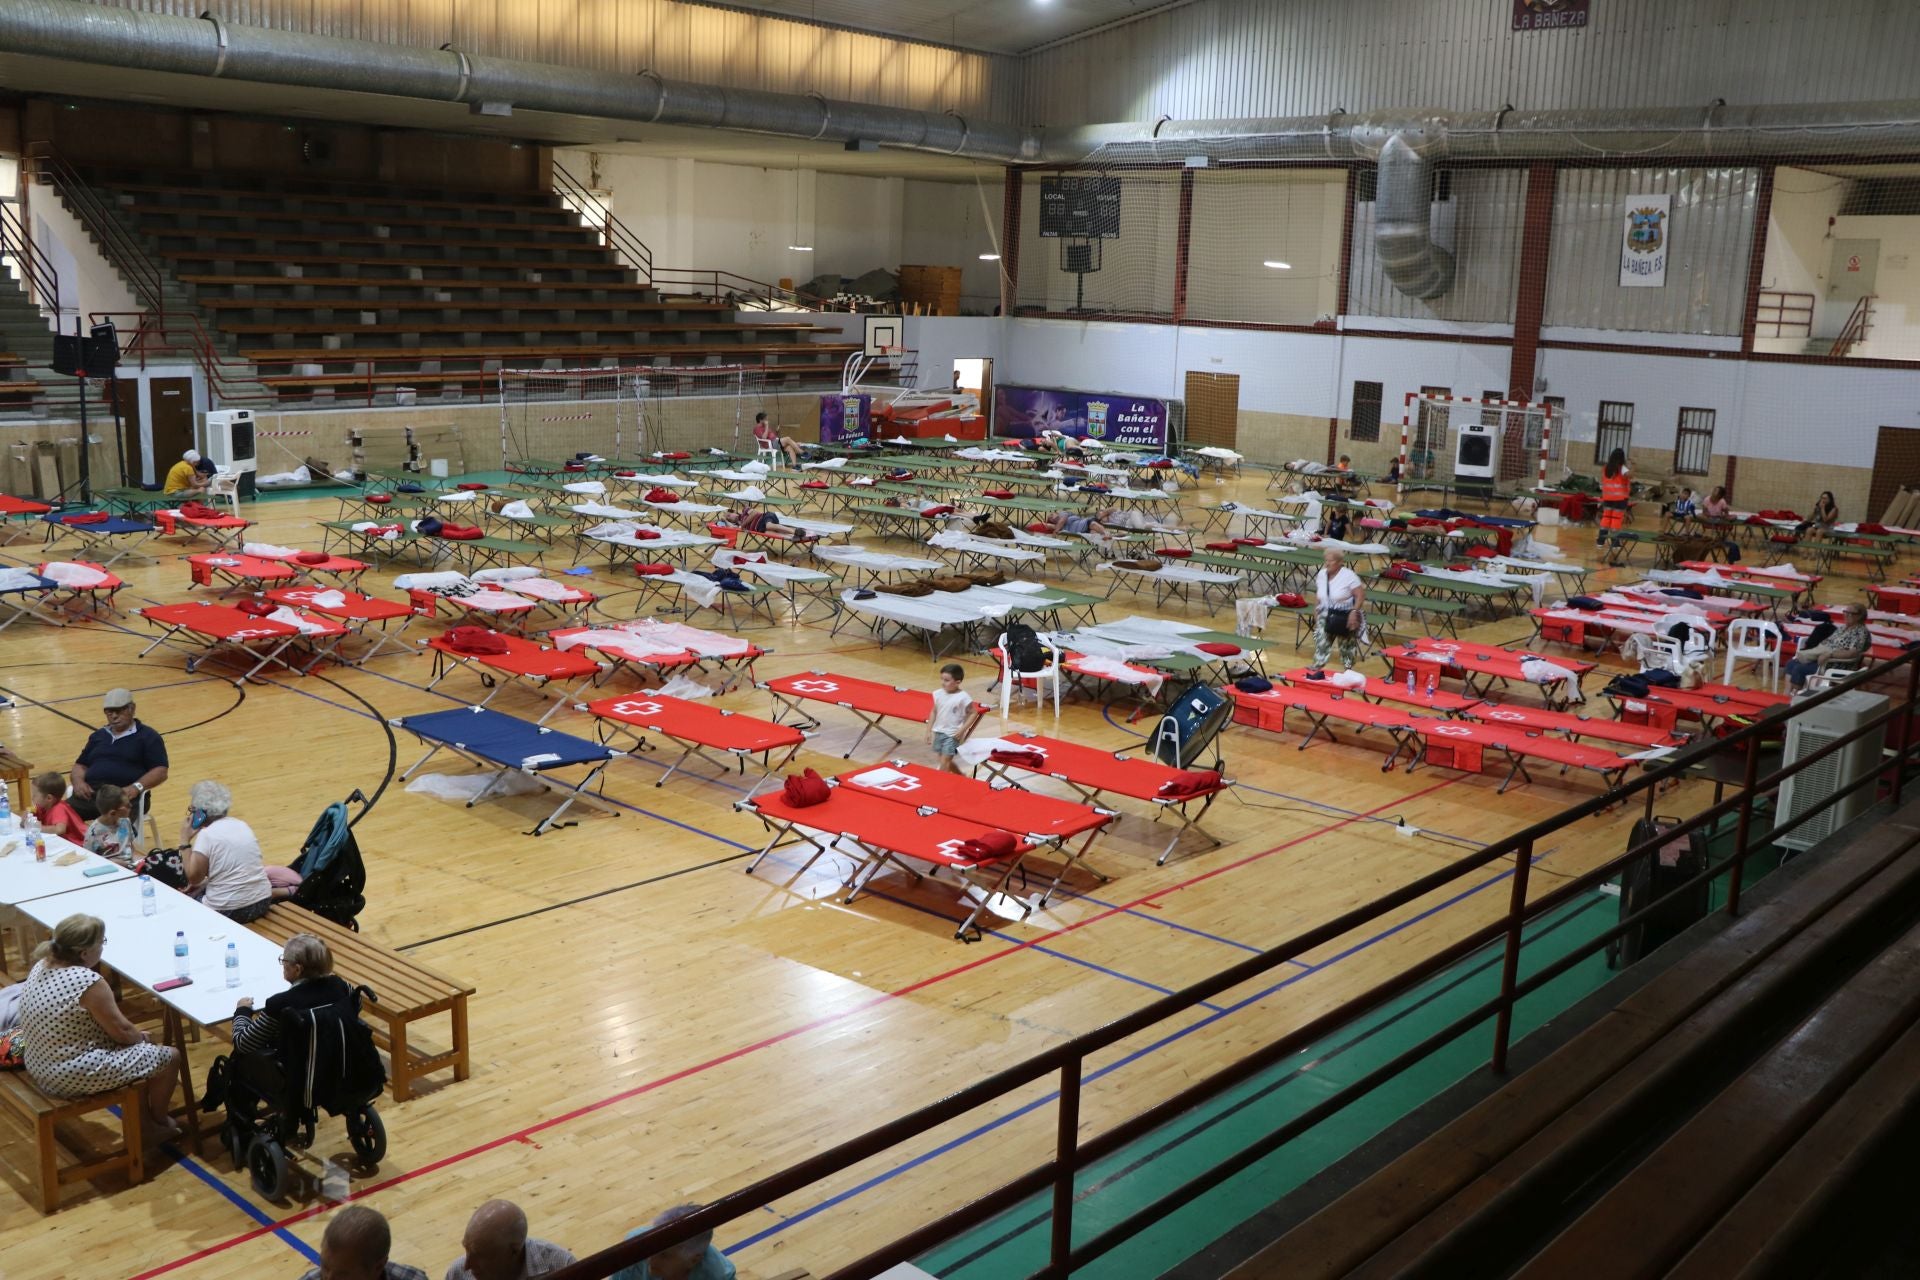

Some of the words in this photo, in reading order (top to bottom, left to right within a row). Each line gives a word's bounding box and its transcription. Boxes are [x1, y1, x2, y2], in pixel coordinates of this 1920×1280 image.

[1513, 14, 1529, 28] LA
[1534, 10, 1586, 28] BAÑEZA
[1131, 403, 1145, 412] La
[1117, 413, 1158, 423] Bañeza
[1120, 425, 1140, 433] con
[1142, 424, 1154, 434] el
[1114, 434, 1159, 444] deporte
